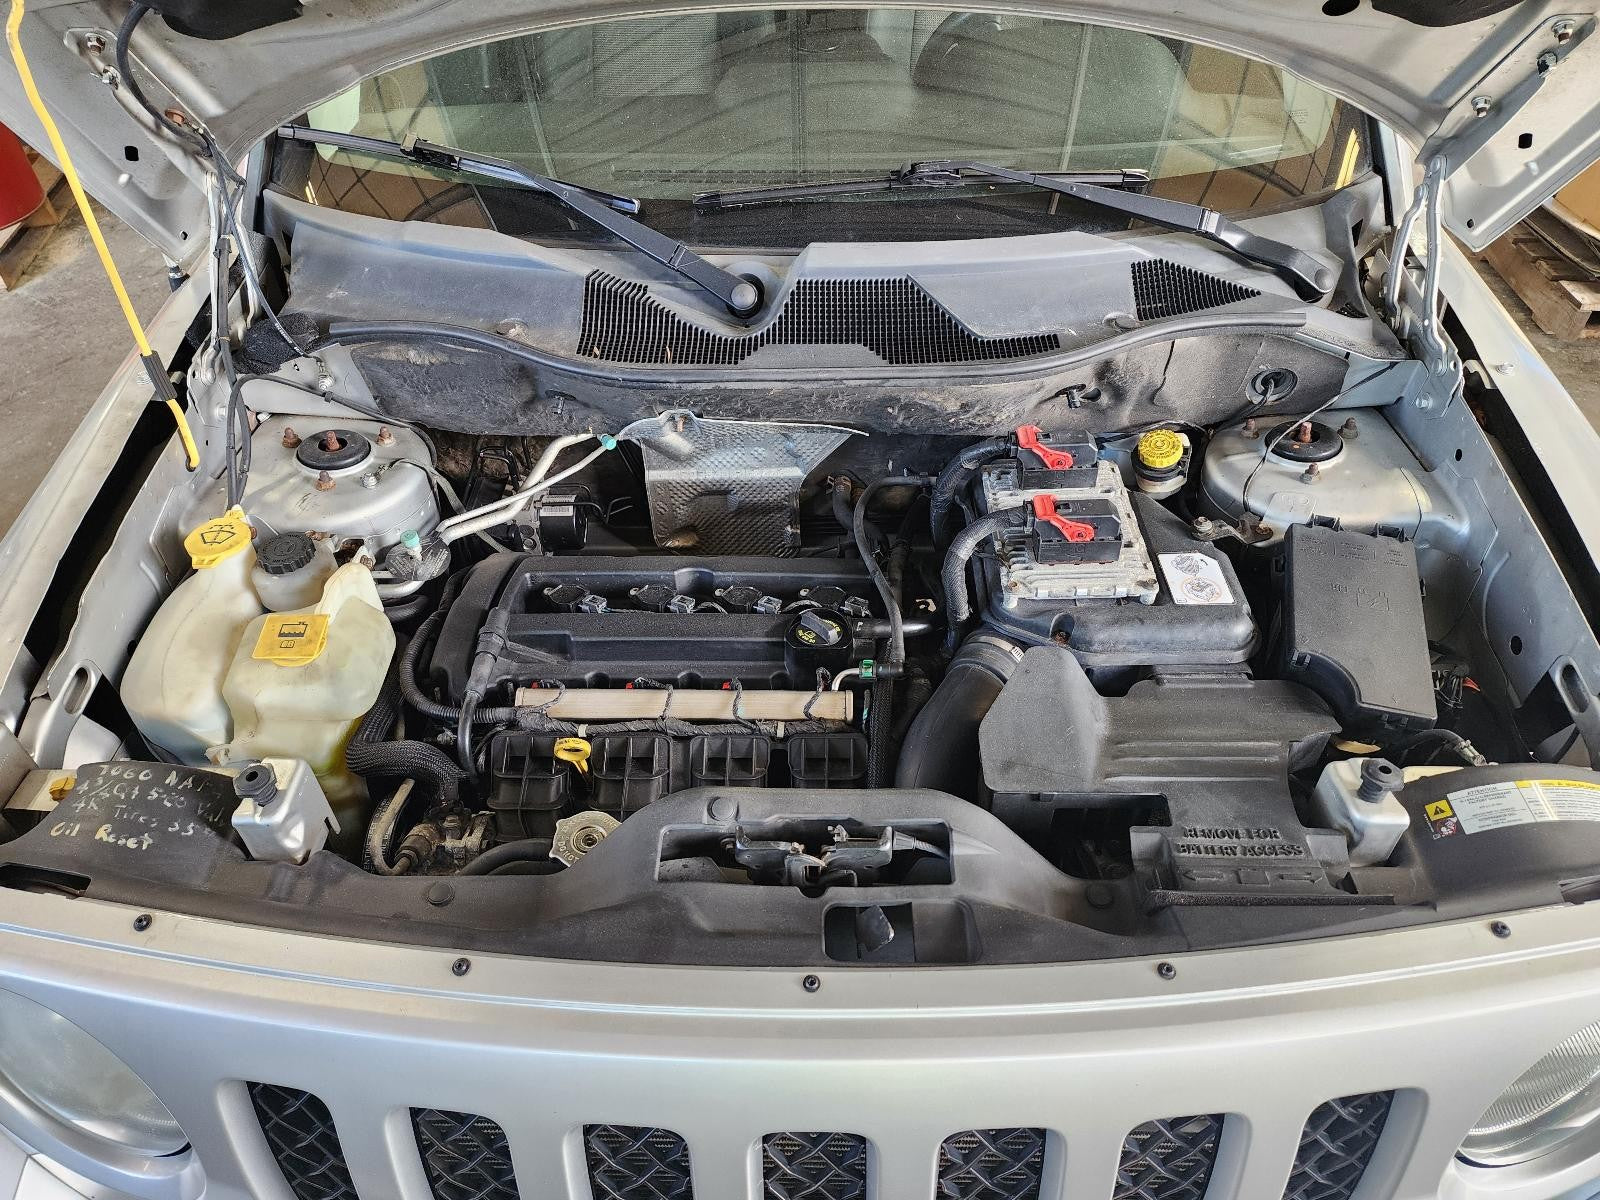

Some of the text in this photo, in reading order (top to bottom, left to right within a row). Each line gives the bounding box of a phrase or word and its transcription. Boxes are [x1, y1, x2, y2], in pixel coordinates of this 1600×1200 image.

[50, 821, 81, 837] Oil
[1183, 828, 1282, 840] REMOVE FOR
[1176, 843, 1304, 857] BATTERY ACCESS
